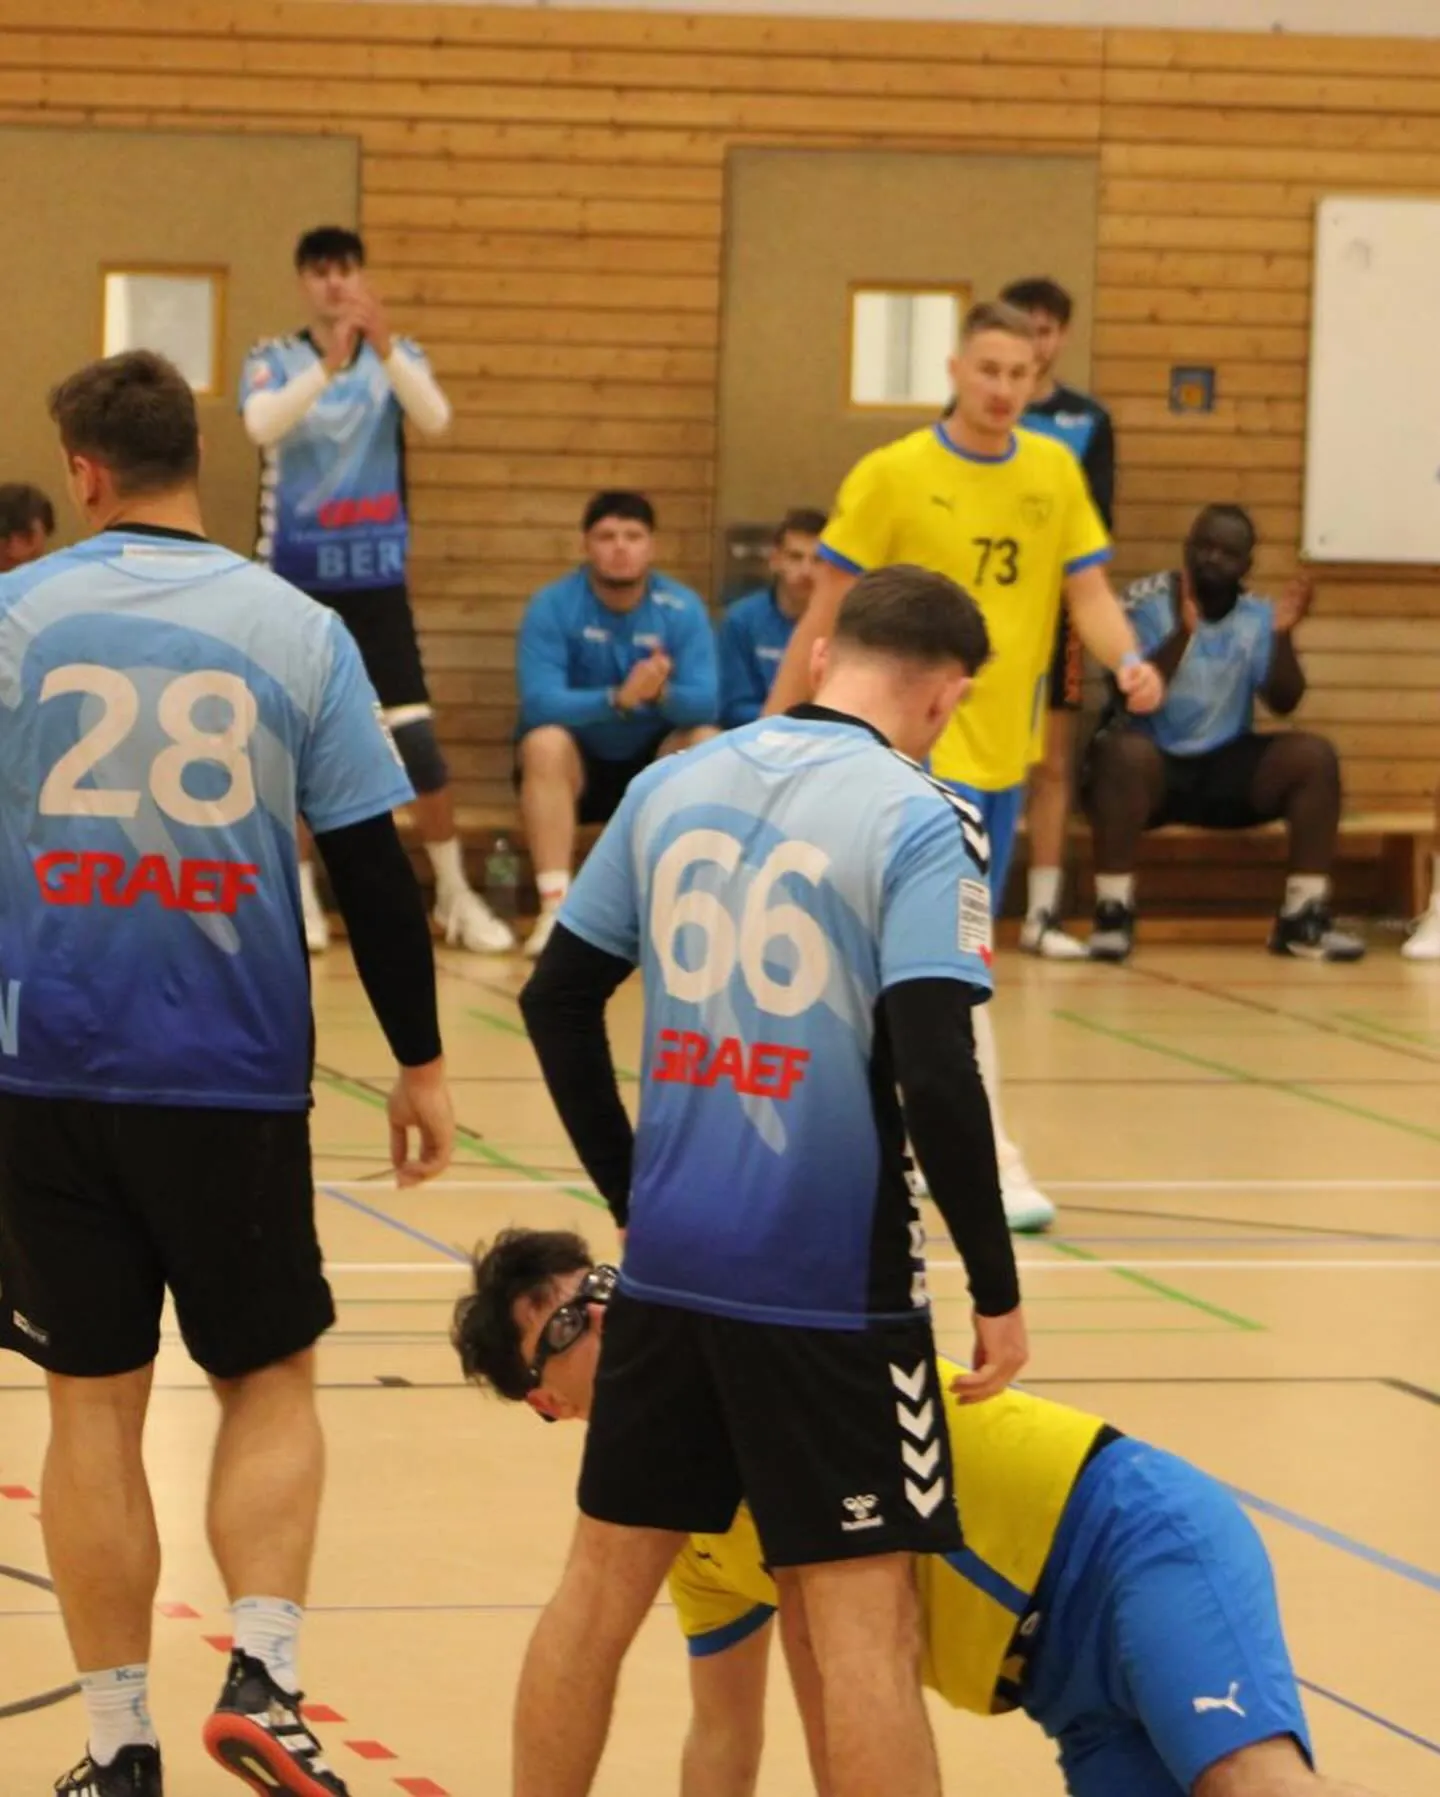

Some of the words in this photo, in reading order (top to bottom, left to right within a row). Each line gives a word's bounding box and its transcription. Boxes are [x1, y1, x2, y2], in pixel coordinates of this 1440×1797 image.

[972, 537, 1018, 586] 73
[38, 663, 258, 827] 28
[33, 849, 260, 915] GRAEF
[650, 828, 830, 1017] 66
